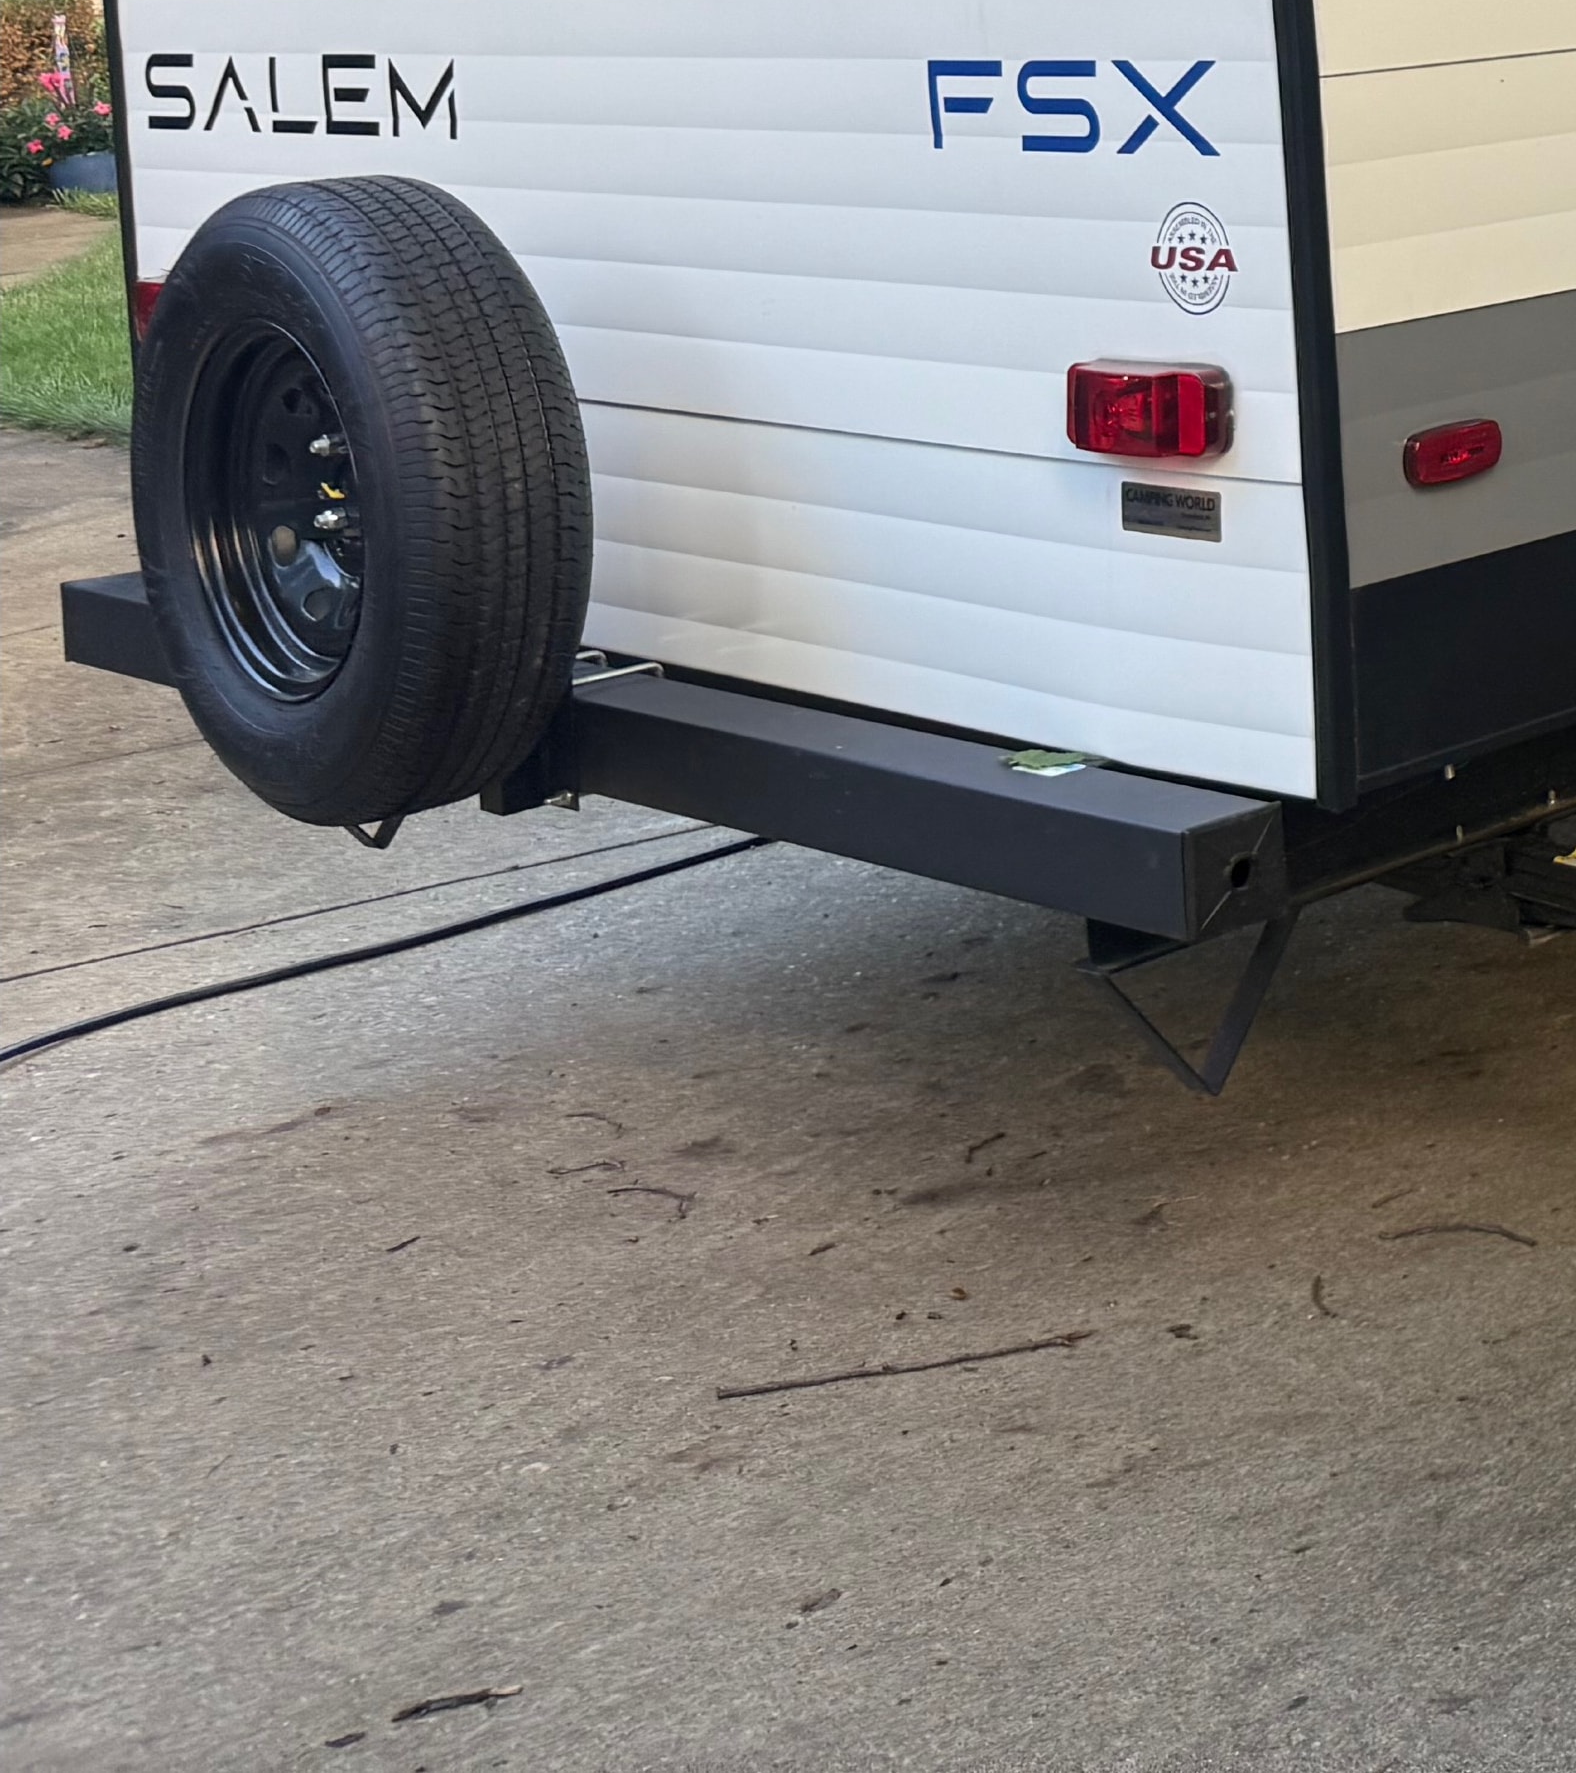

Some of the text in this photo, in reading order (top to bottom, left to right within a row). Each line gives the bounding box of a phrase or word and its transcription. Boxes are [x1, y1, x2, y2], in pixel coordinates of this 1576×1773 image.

[145, 53, 458, 140] SALEM
[927, 59, 1221, 157] FSX
[1151, 245, 1238, 272] USA
[1175, 494, 1216, 512] WORLD
